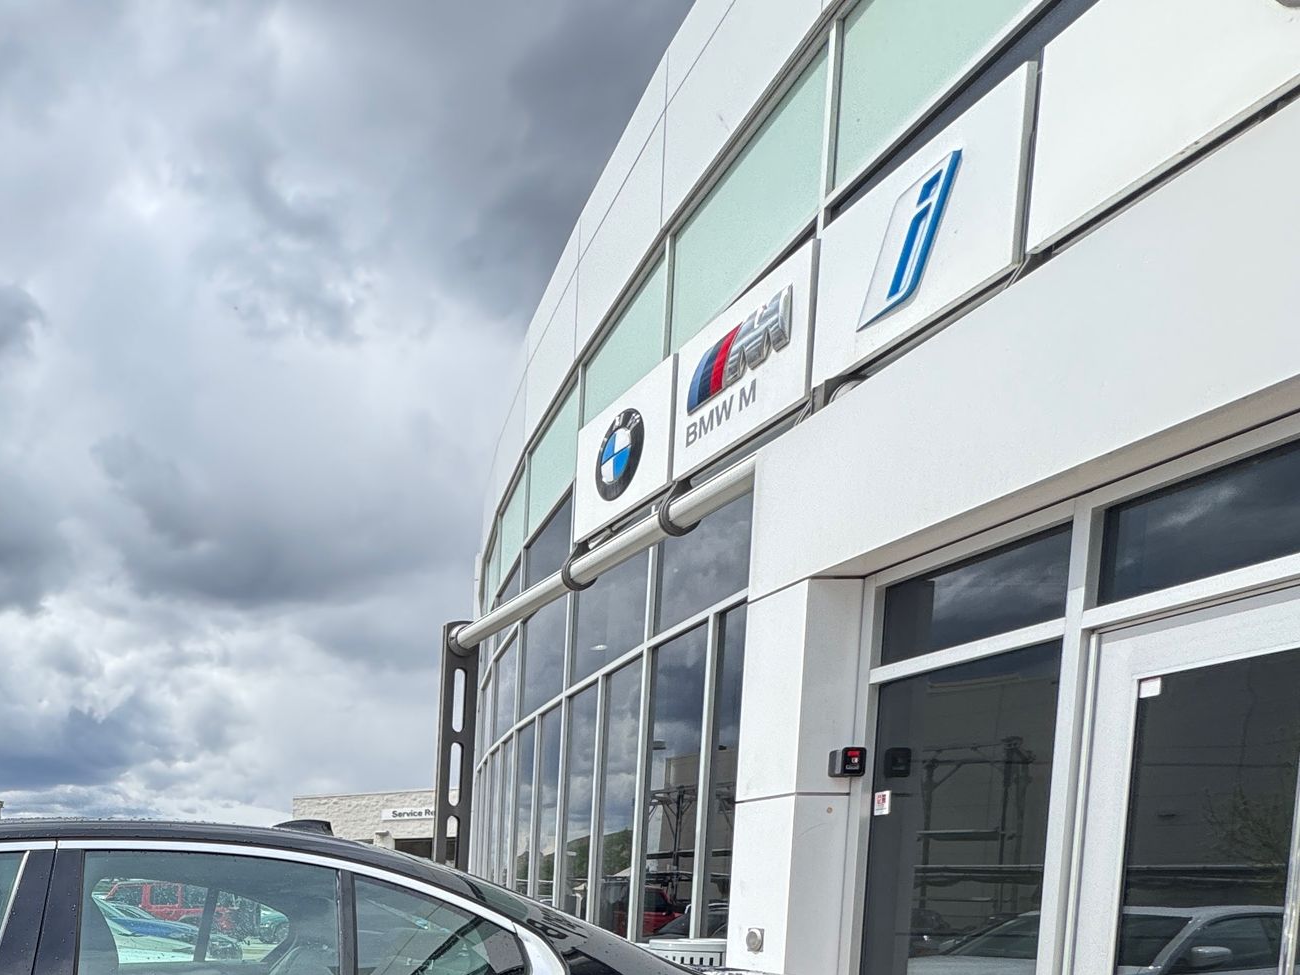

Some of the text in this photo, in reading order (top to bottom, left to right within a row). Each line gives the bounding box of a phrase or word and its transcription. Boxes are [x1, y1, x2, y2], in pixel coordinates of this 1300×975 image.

[685, 377, 757, 448] BMW M
[392, 810, 423, 818] Service
